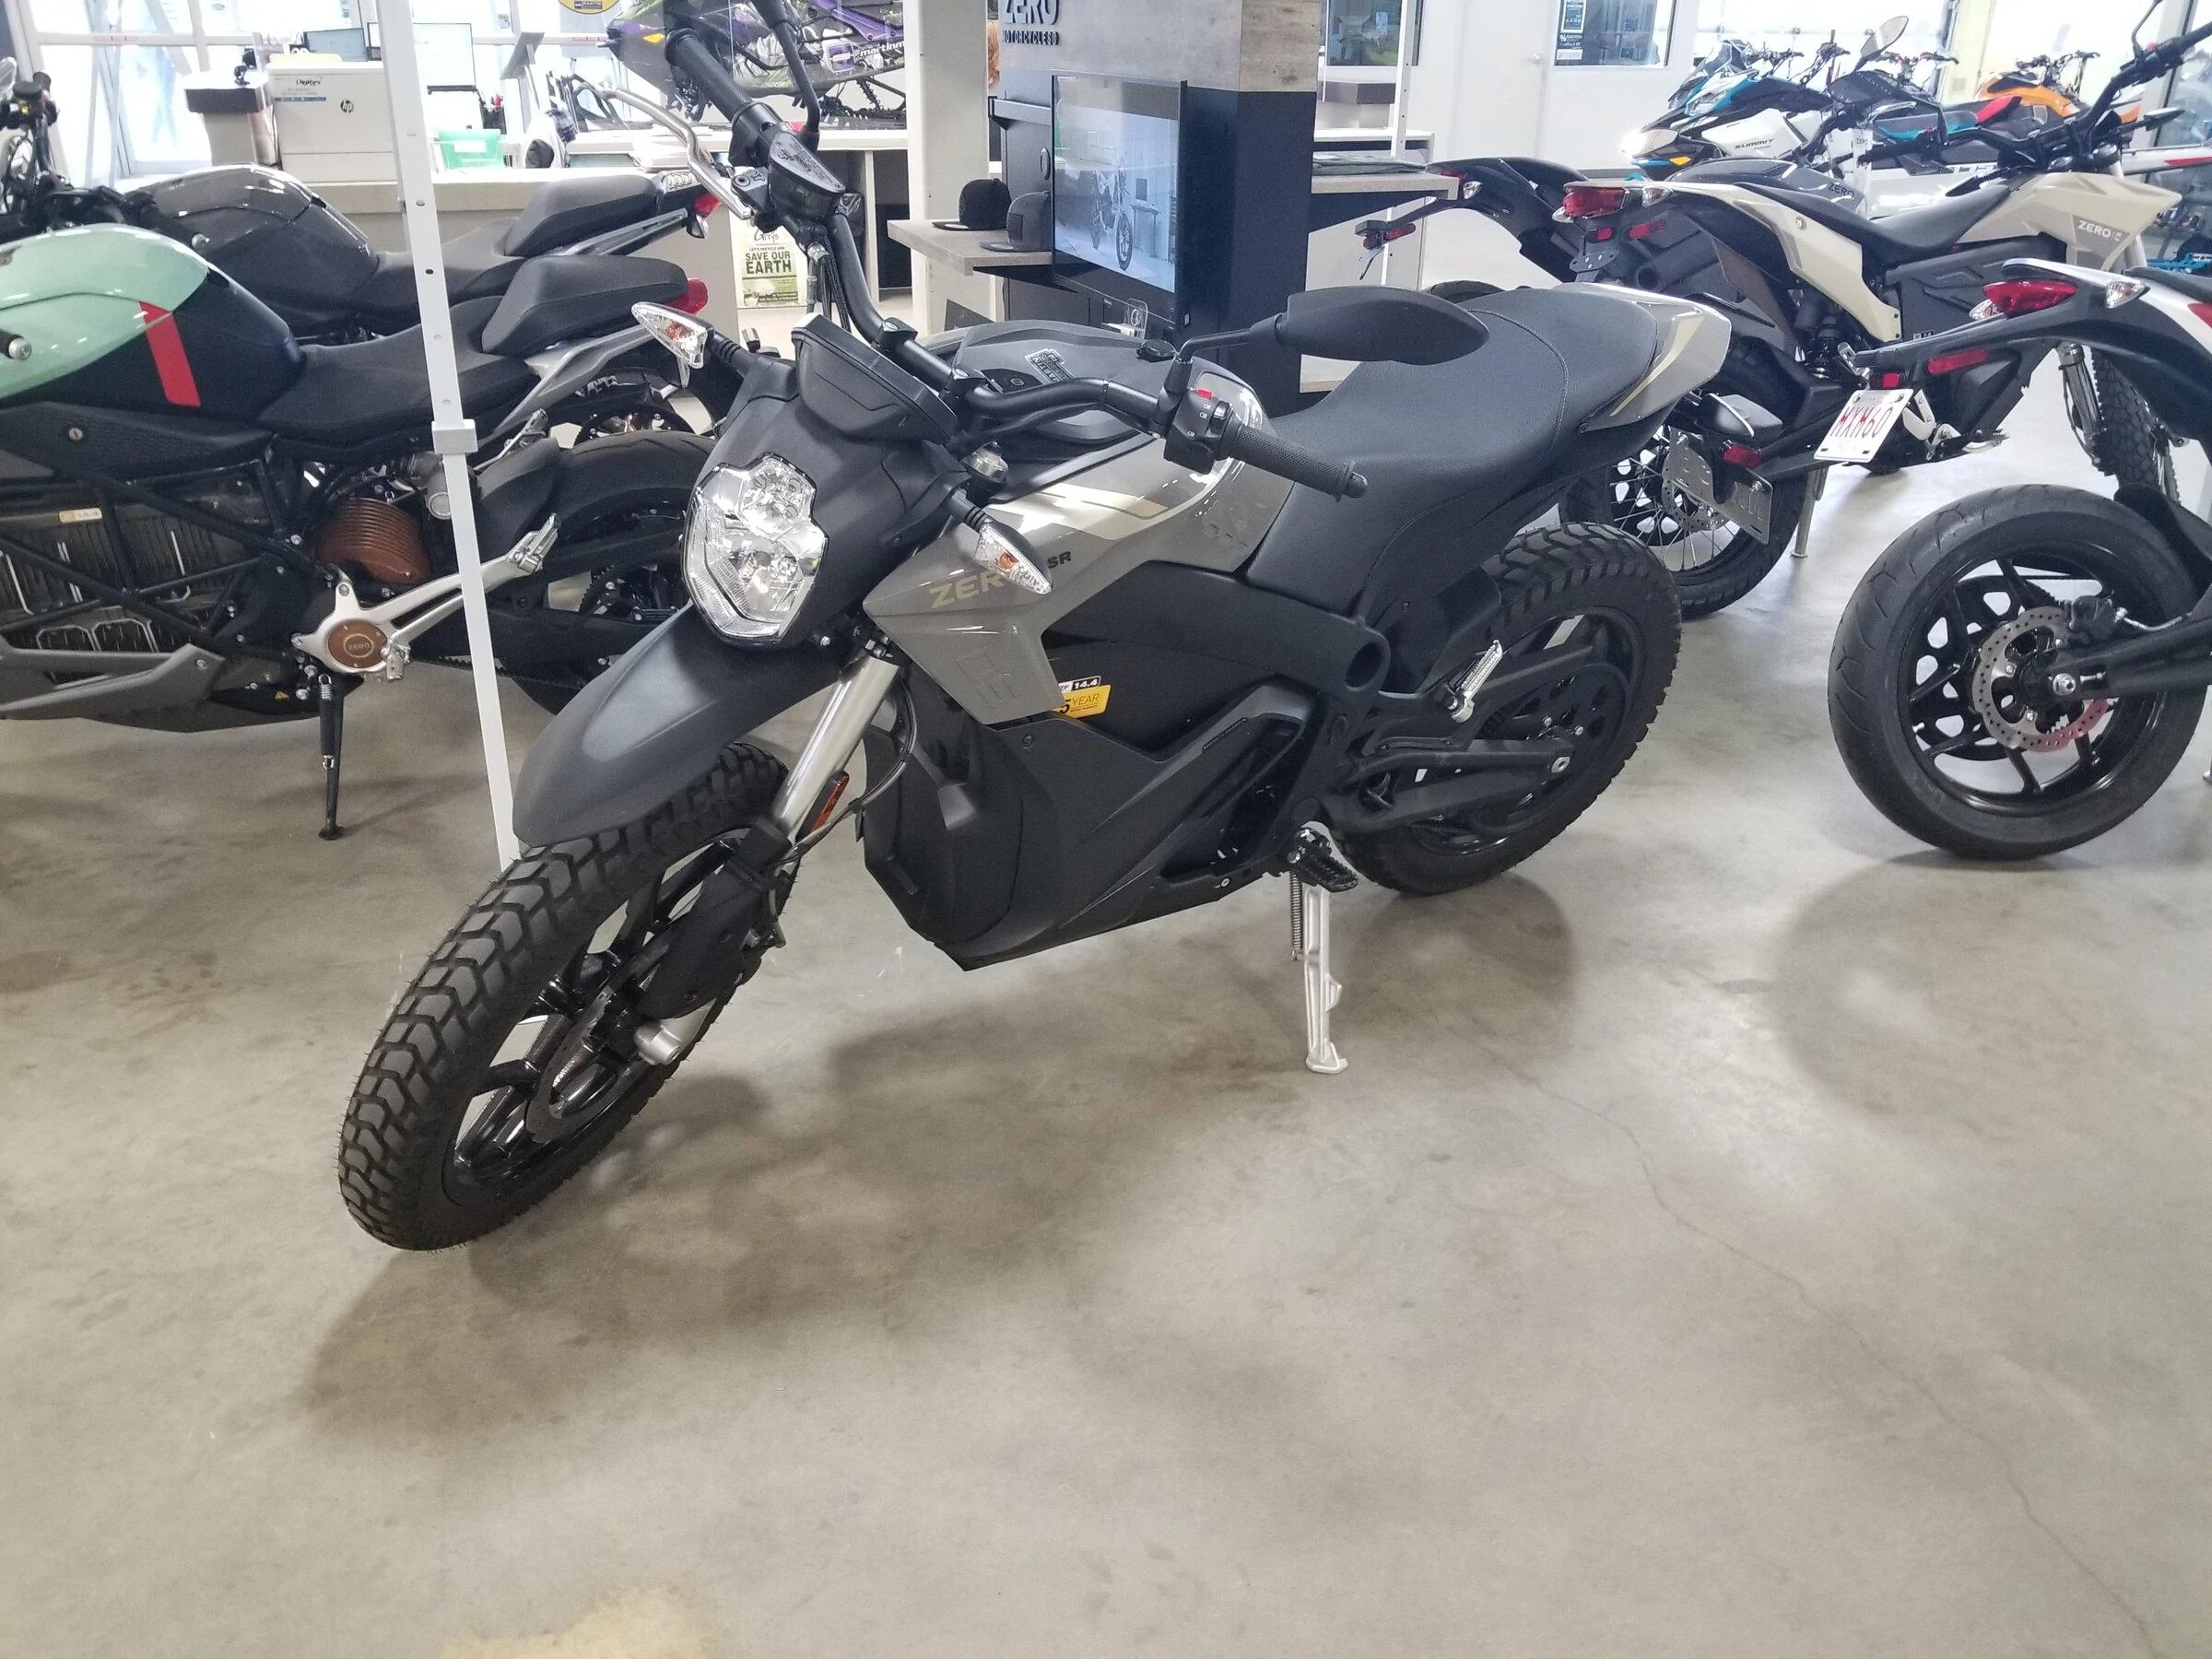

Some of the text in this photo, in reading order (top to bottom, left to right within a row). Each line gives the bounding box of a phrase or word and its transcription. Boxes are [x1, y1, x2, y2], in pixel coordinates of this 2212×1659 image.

[2077, 219, 2111, 238] ZERO
[745, 251, 791, 262] SAVE OUR
[746, 260, 792, 275] EARTH
[1075, 678, 1098, 689] 14.4
[1071, 693, 1100, 706] YEAR
